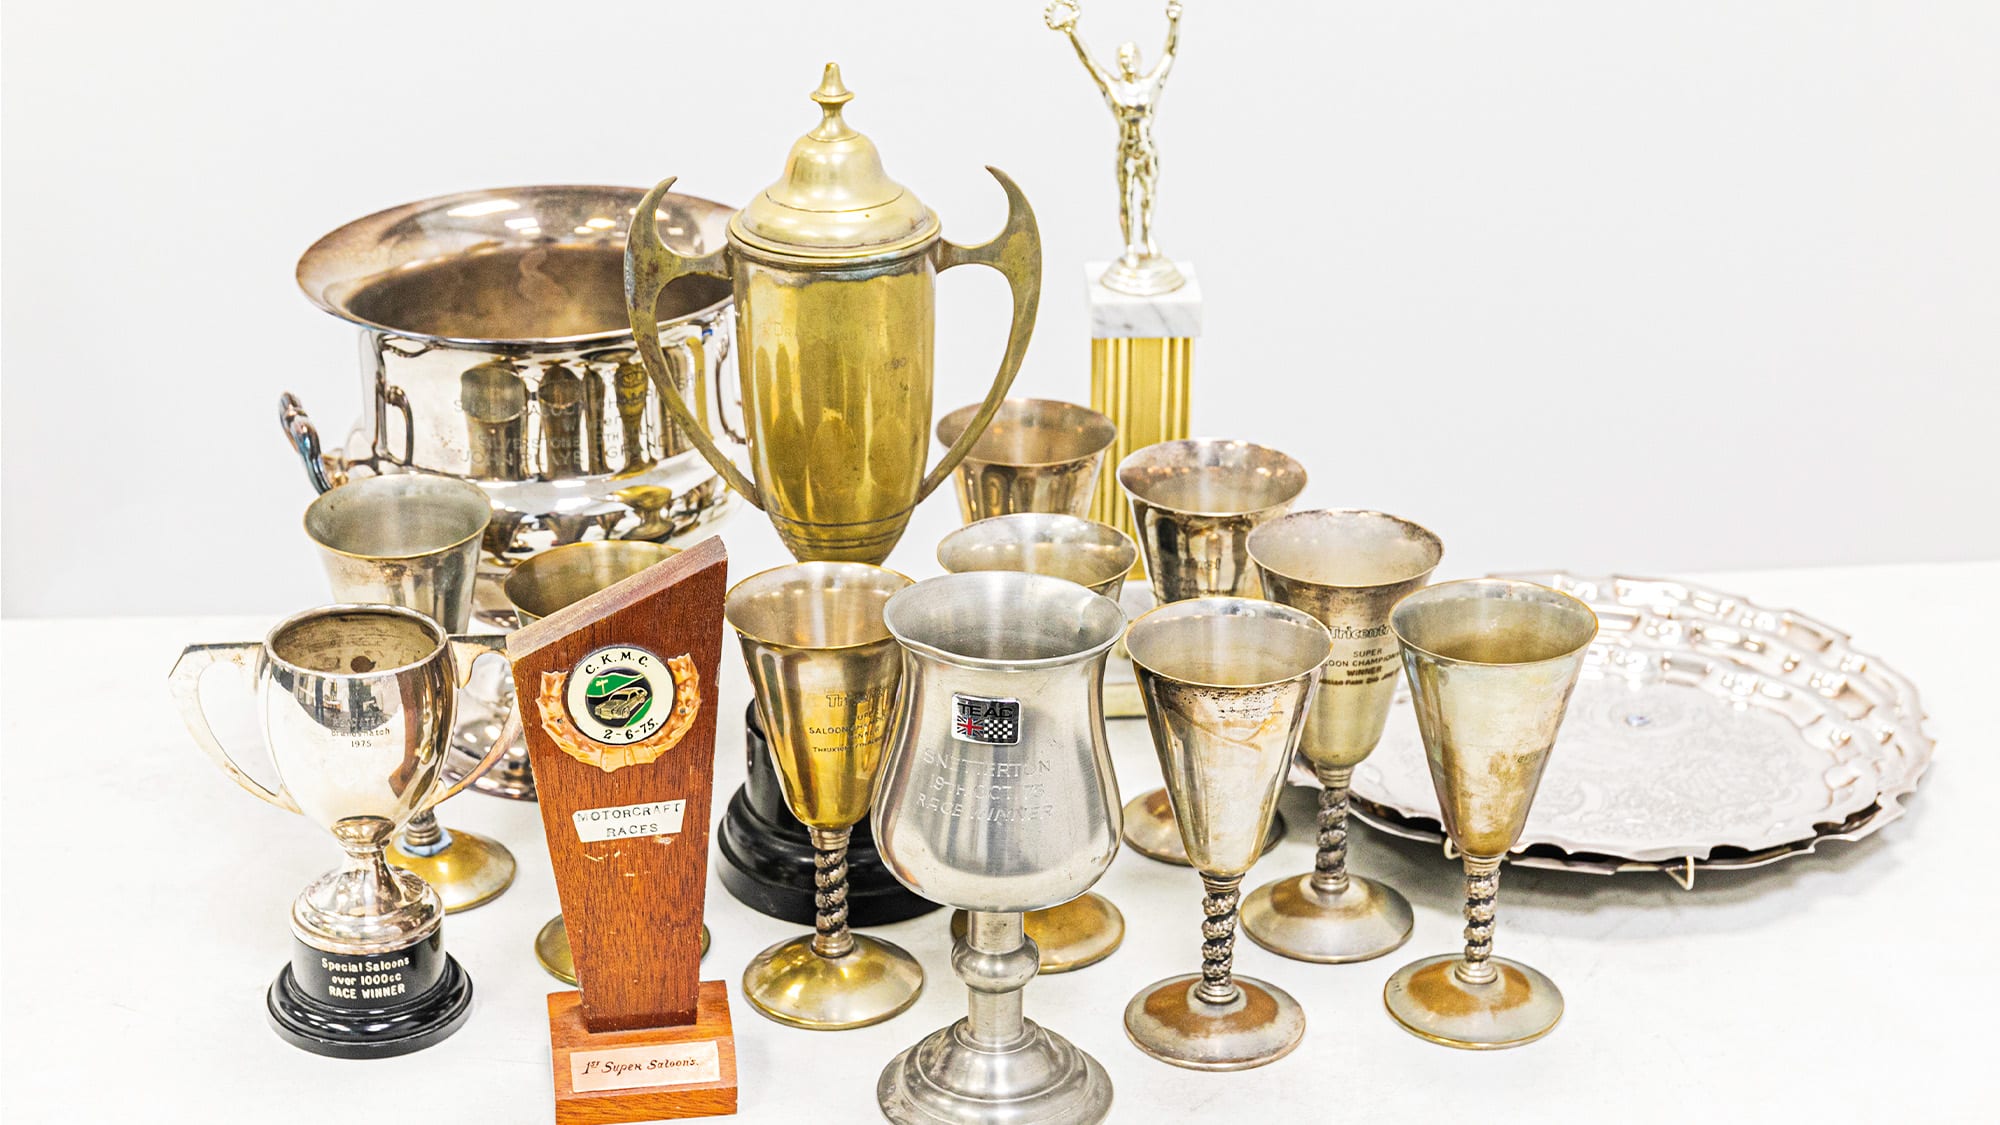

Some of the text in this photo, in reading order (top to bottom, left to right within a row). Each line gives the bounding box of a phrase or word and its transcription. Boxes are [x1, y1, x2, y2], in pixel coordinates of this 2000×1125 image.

[1353, 648, 1382, 658] SUPER
[957, 702, 1013, 718] TEAC
[351, 740, 373, 748] 1975
[577, 802, 681, 822] MOTORCRAFT
[917, 792, 962, 817] RACE
[606, 823, 659, 837] RACES
[321, 956, 410, 973] Special Saloons
[331, 972, 402, 986] over 1000cc
[328, 983, 406, 999] RACE WINNER
